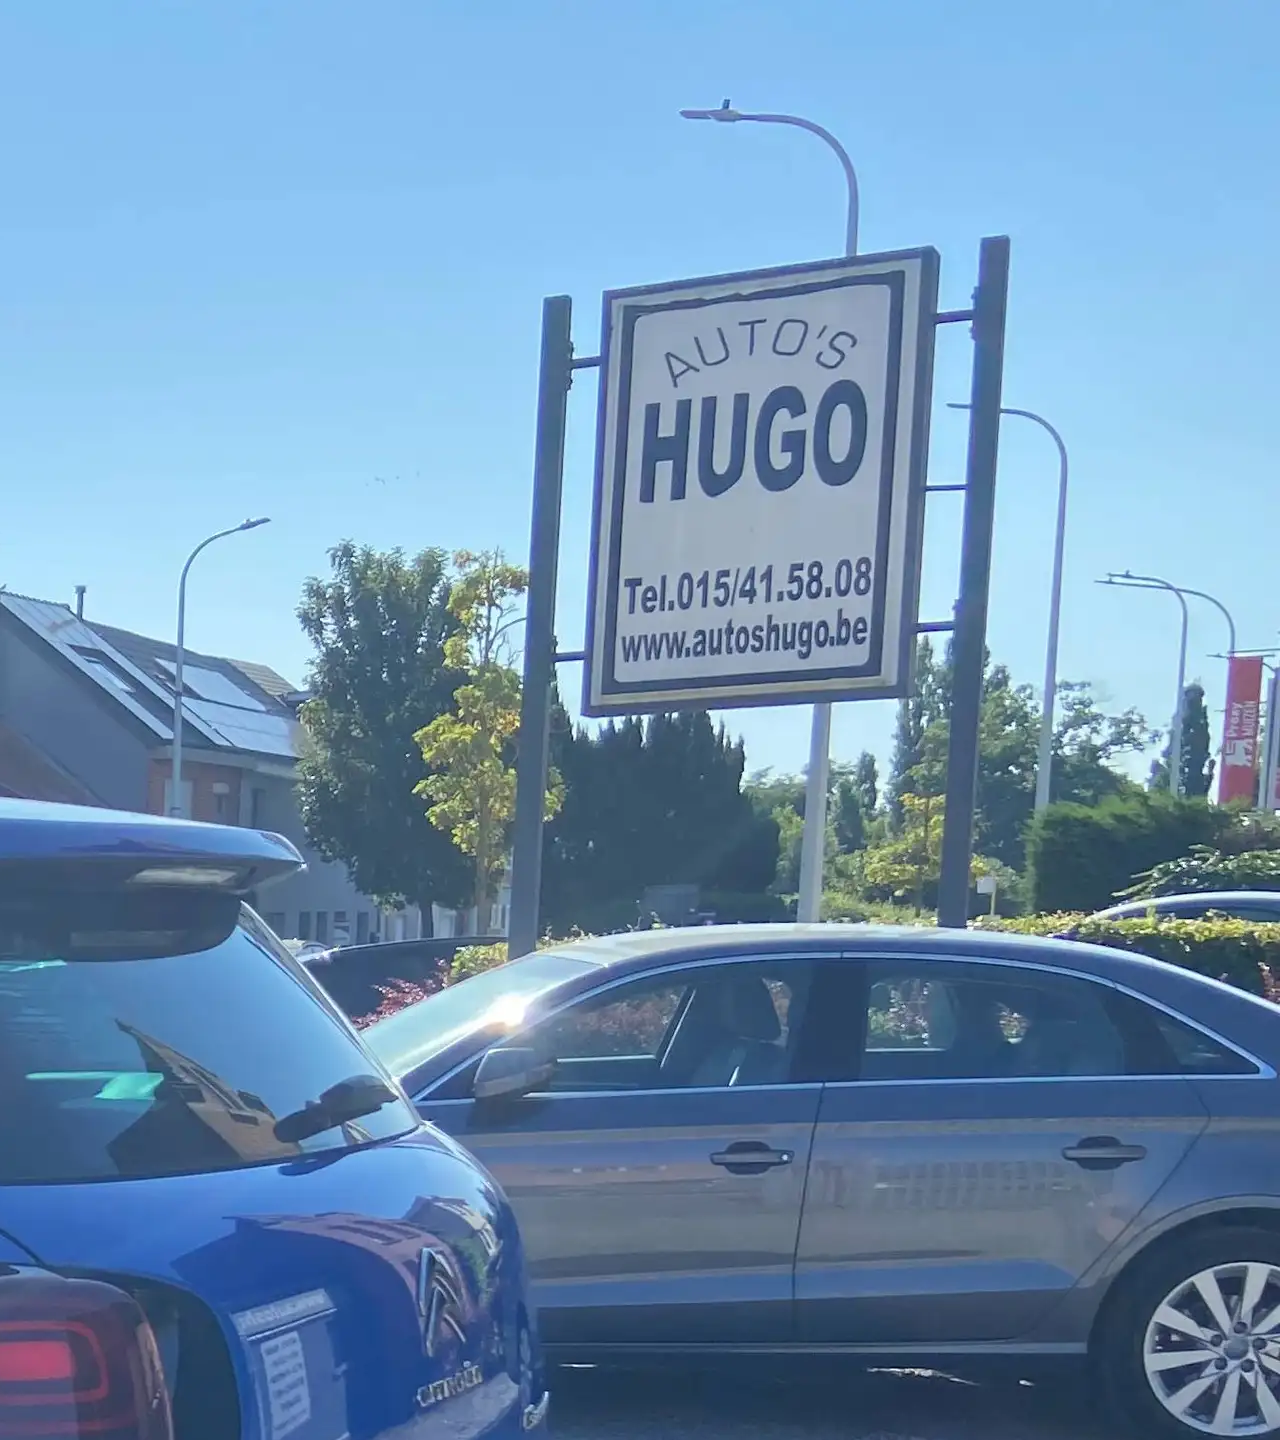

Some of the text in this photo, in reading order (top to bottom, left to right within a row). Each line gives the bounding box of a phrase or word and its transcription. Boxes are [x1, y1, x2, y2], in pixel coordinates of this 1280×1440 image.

[663, 317, 858, 388] AUTO'S
[639, 378, 868, 504] HUGO
[623, 556, 873, 615] Tel.015/41.58.08
[621, 609, 868, 663] www.autoshugo.be
